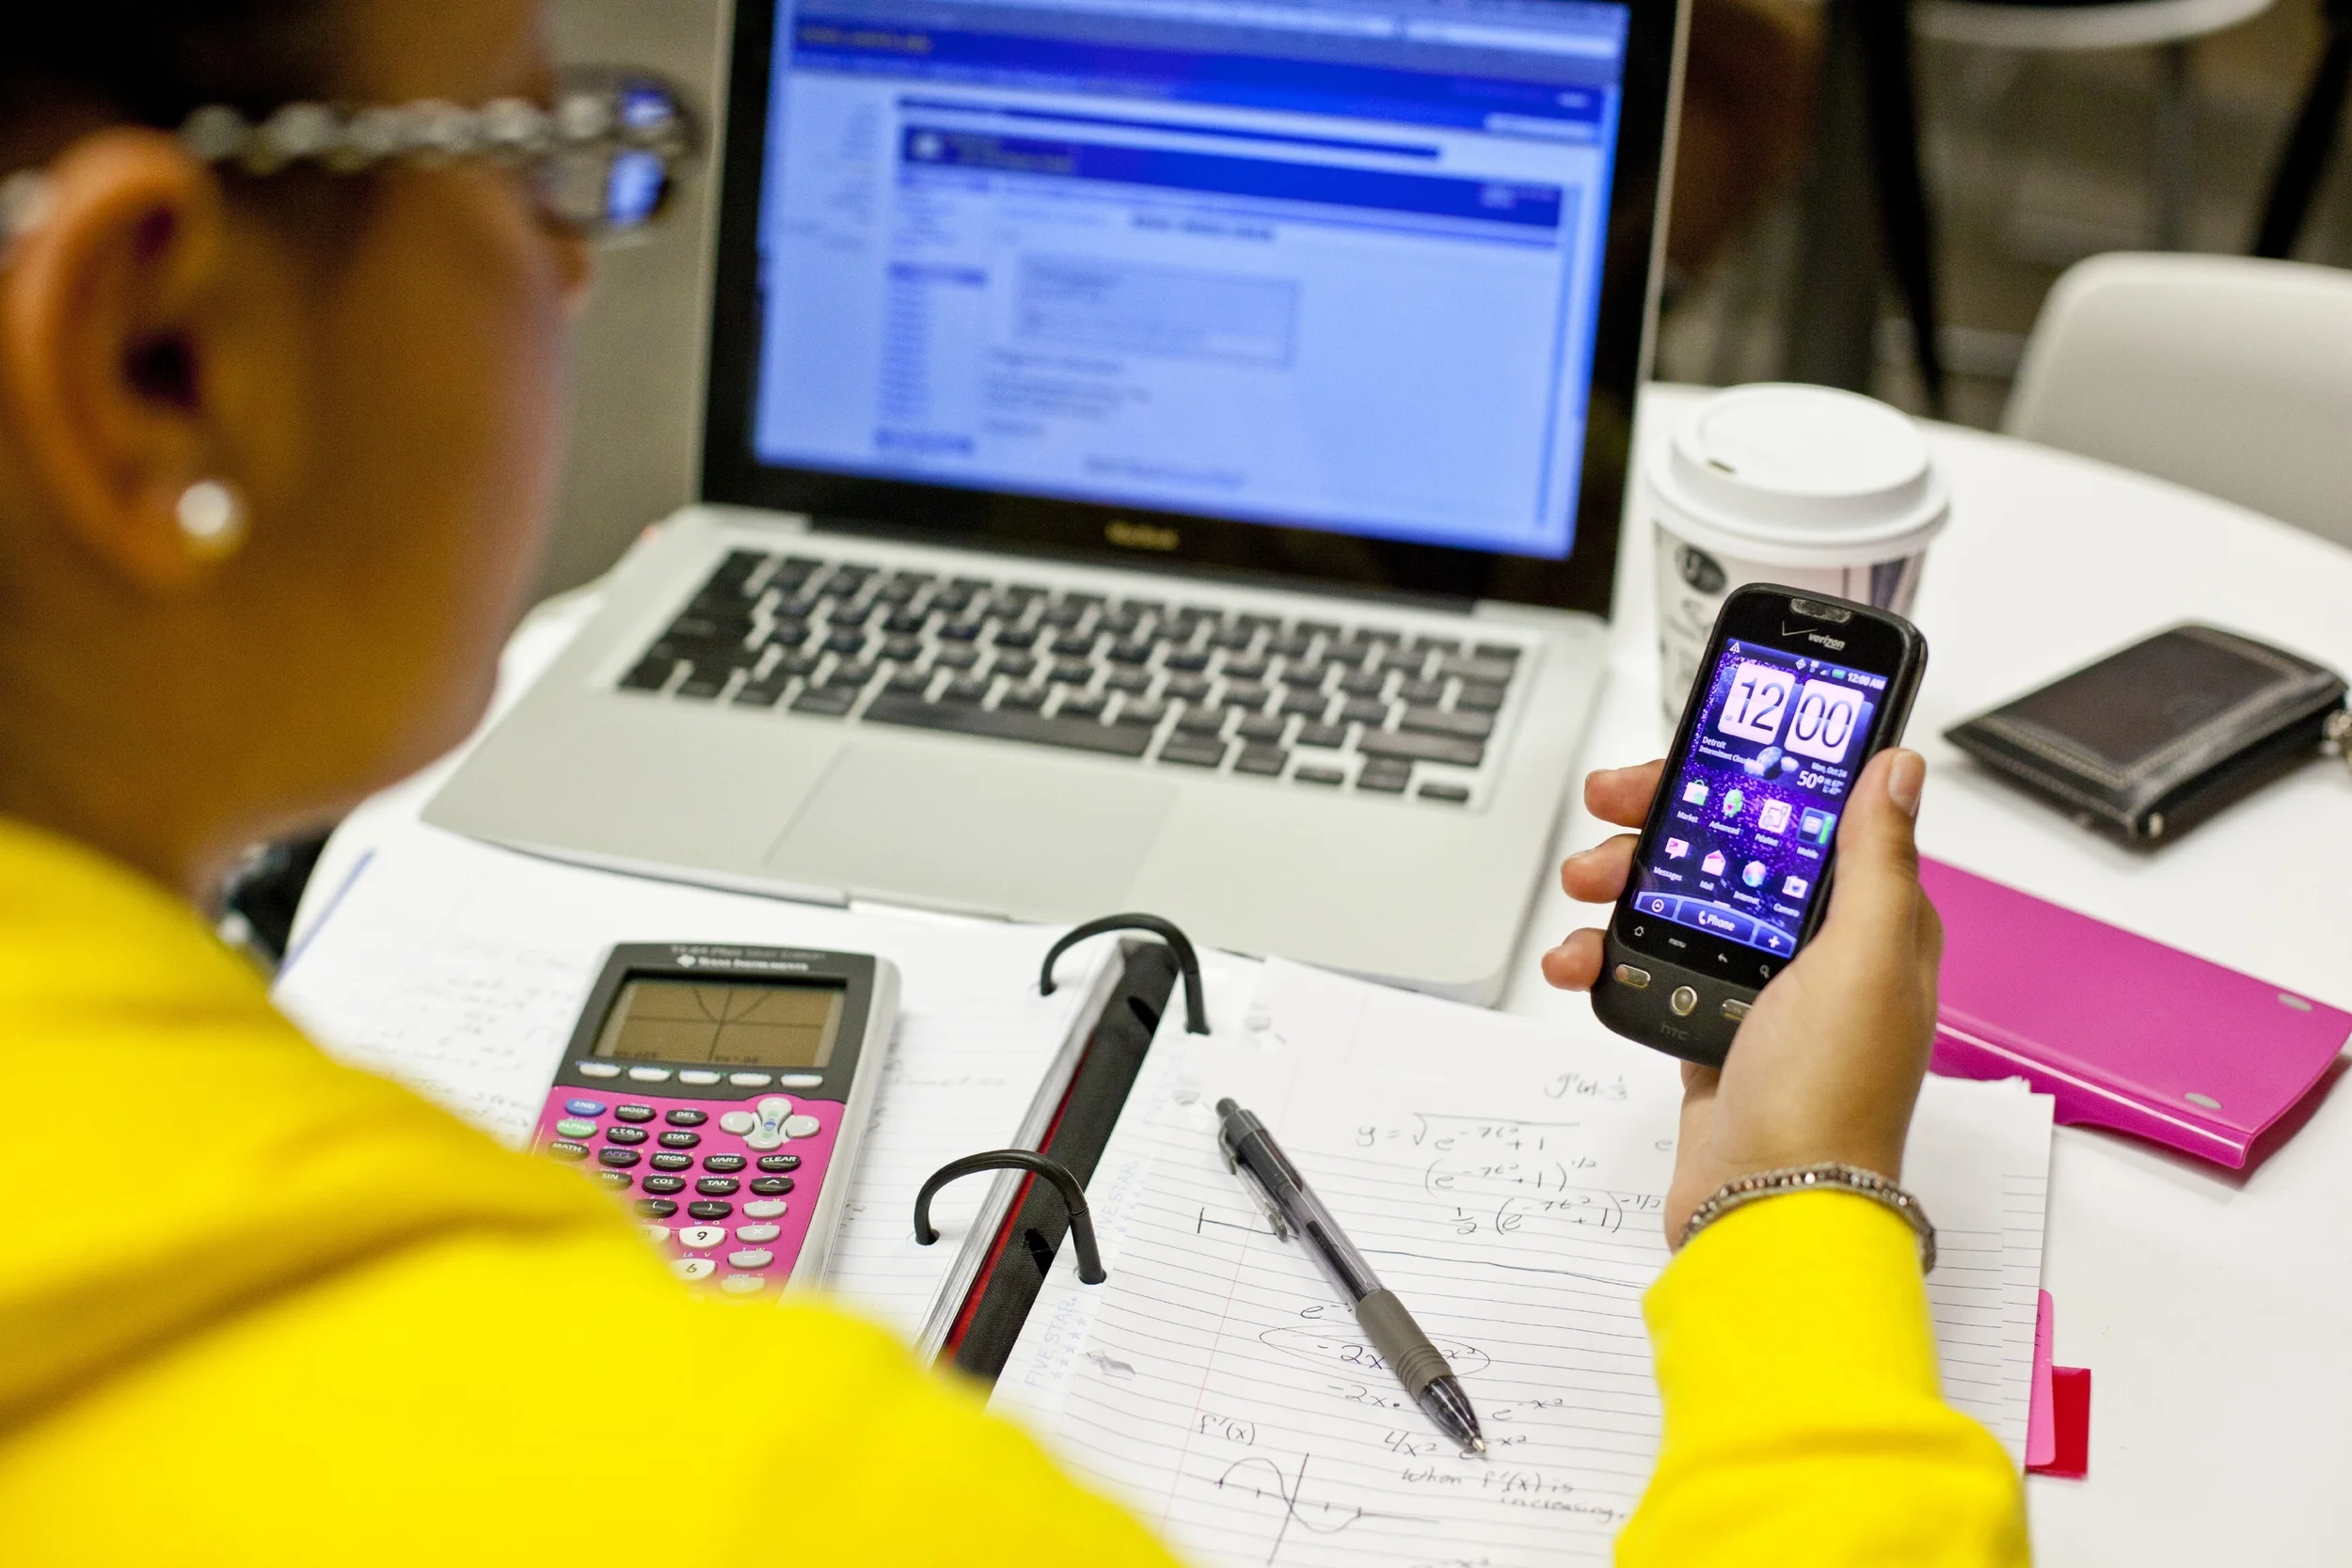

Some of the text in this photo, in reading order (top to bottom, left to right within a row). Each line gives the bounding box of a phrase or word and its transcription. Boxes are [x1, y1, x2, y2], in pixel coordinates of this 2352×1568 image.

[1808, 633, 1846, 651] verizon
[1848, 673, 1886, 689] 12:00 AM
[1738, 677, 1852, 748] 12 00
[1702, 736, 1726, 750] Detroit
[1699, 745, 1732, 761] Intermittent
[1677, 811, 1699, 823] Market
[1708, 820, 1740, 835] Advanced
[1796, 847, 1820, 860] Mobile
[1653, 866, 1682, 881] Messages
[1699, 880, 1714, 891] Mail
[1733, 891, 1760, 905] Internet
[1773, 903, 1800, 917] Camera
[1707, 913, 1736, 931] Phone
[1668, 938, 1687, 948] menu
[574, 1101, 596, 1109] 2ND
[619, 1106, 650, 1115] MODE
[558, 1122, 592, 1132] ALPHA
[552, 1143, 582, 1152] MATH
[1108, 1163, 1136, 1202] STAR
[697, 1231, 707, 1241] 9
[686, 1263, 697, 1274] 6
[1025, 1300, 1075, 1386] FIVE STAR
